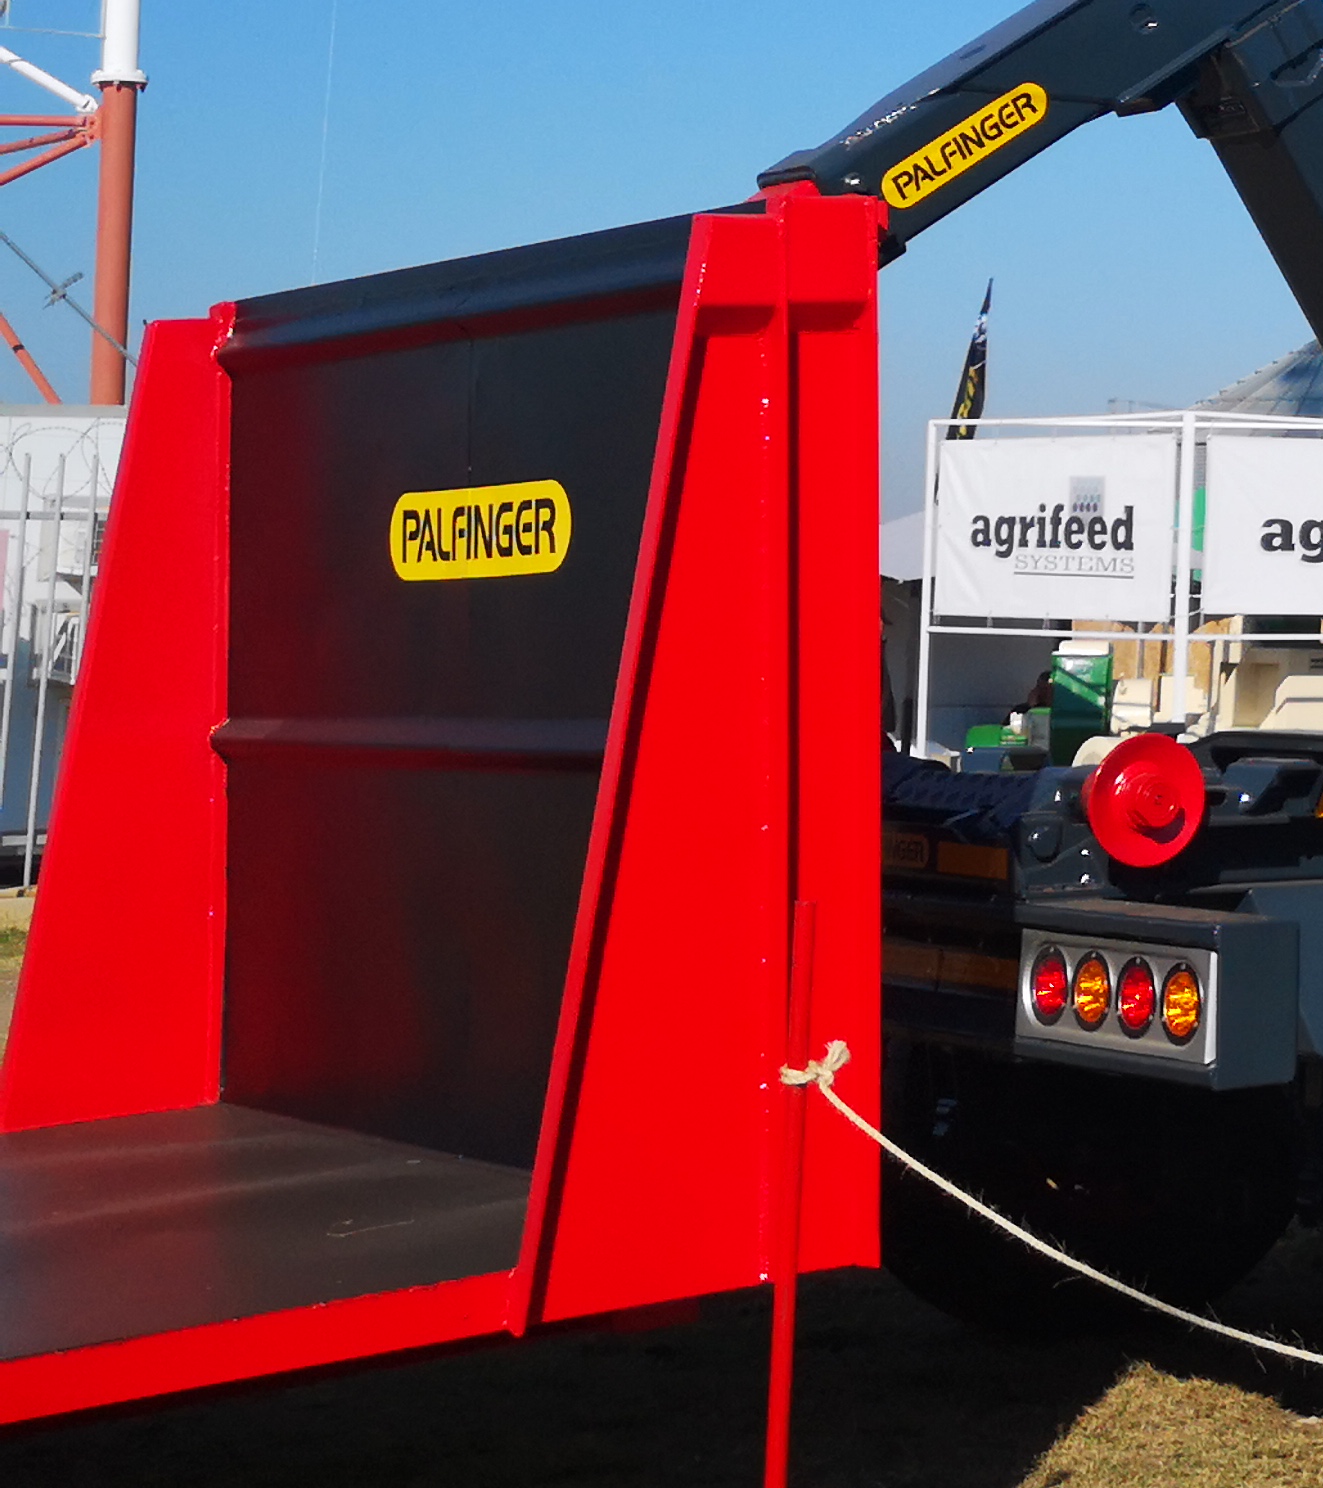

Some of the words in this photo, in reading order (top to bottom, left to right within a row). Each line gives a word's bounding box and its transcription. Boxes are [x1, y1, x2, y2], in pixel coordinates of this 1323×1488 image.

[891, 92, 1039, 201] PALFINGER
[401, 497, 556, 564] PALFINGER
[970, 503, 1135, 559] agrifeed
[1014, 554, 1135, 575] SYSTEMS
